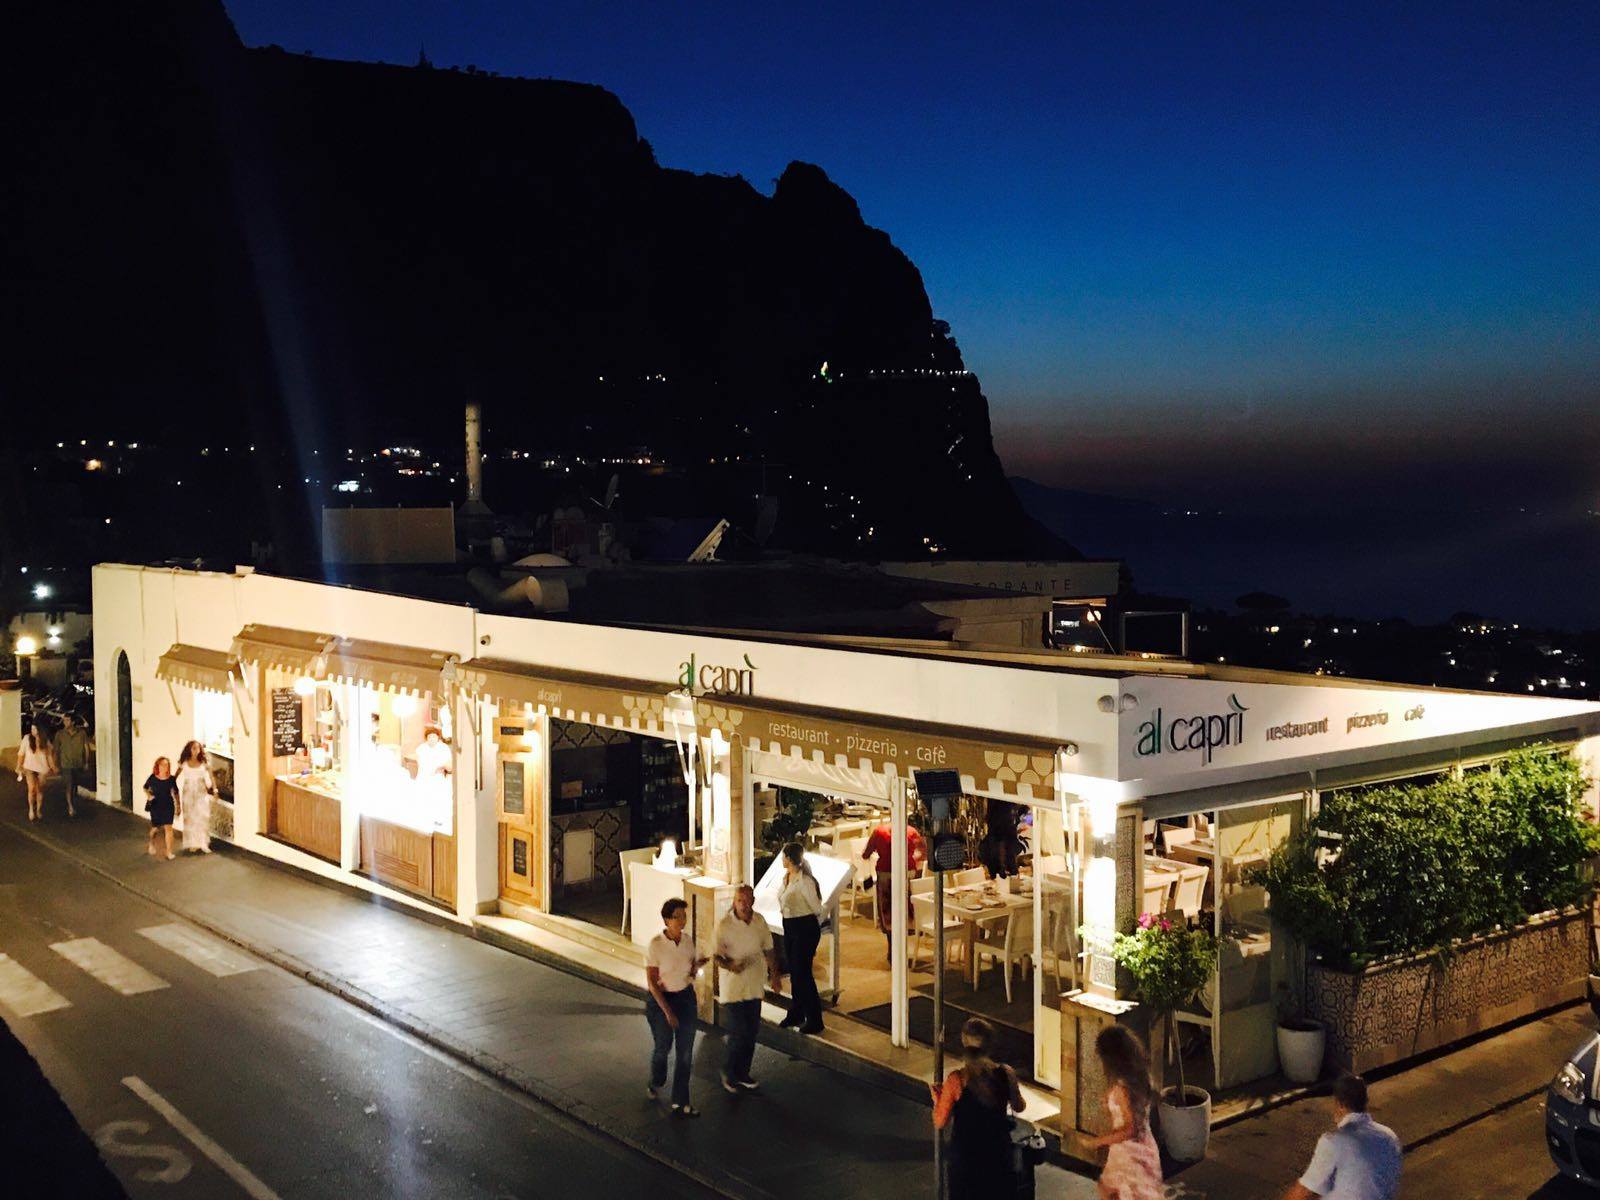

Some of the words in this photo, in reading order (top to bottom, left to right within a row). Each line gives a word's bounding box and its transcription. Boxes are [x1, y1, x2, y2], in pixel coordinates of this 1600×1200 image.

[678, 652, 695, 690] al
[767, 721, 830, 745] restaurant
[846, 732, 898, 758] pizzeria
[916, 744, 947, 766] cafè
[1137, 707, 1161, 756] al
[1170, 693, 1250, 763] caprì
[1265, 716, 1329, 742] restaurant
[1346, 709, 1389, 734] pizzeria
